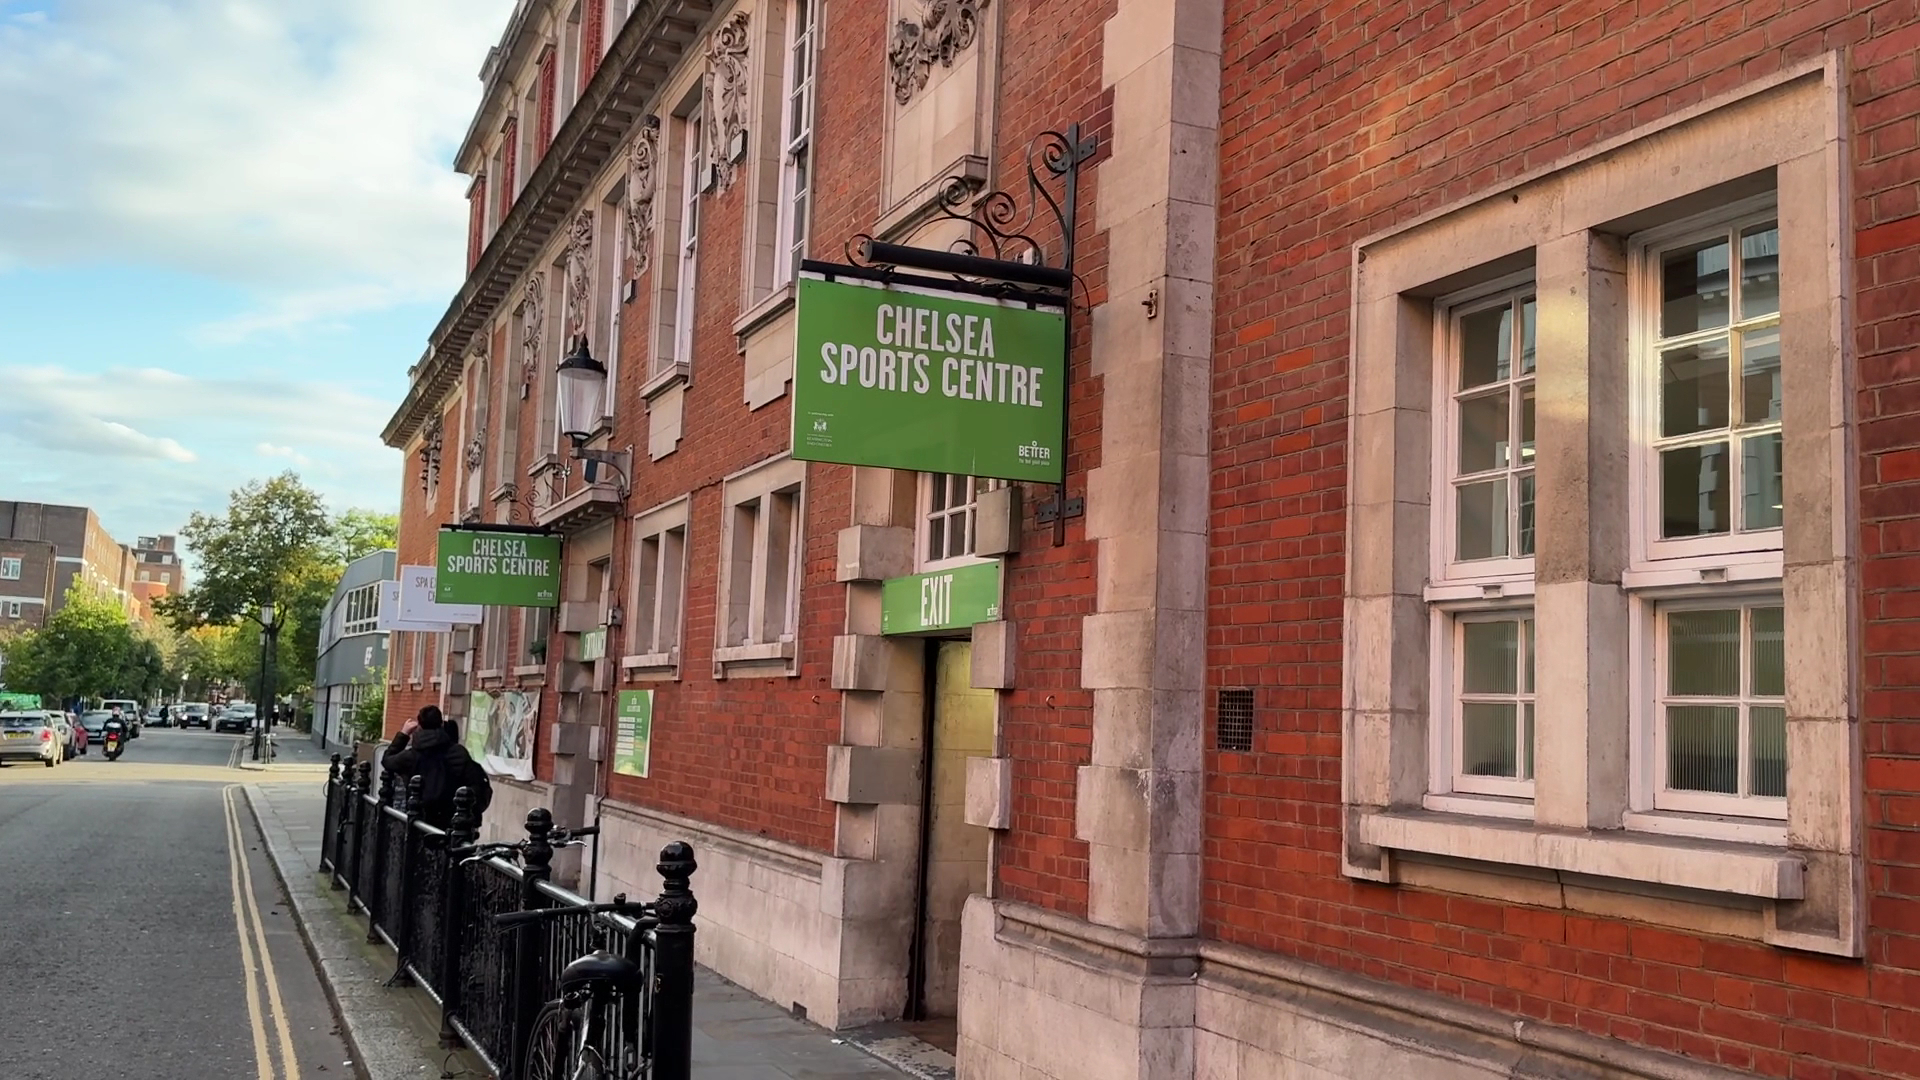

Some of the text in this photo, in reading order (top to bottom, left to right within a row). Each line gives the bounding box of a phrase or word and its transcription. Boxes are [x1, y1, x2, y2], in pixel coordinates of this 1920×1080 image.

[876, 303, 995, 358] CHELSEA
[820, 342, 1044, 407] SPORTS CENTRE
[1018, 445, 1050, 459] BETTER
[472, 538, 527, 557] CHELSEA
[447, 555, 550, 576] SPORTS CENTRE
[415, 576, 436, 589] SPA E
[920, 574, 953, 626] EXIT
